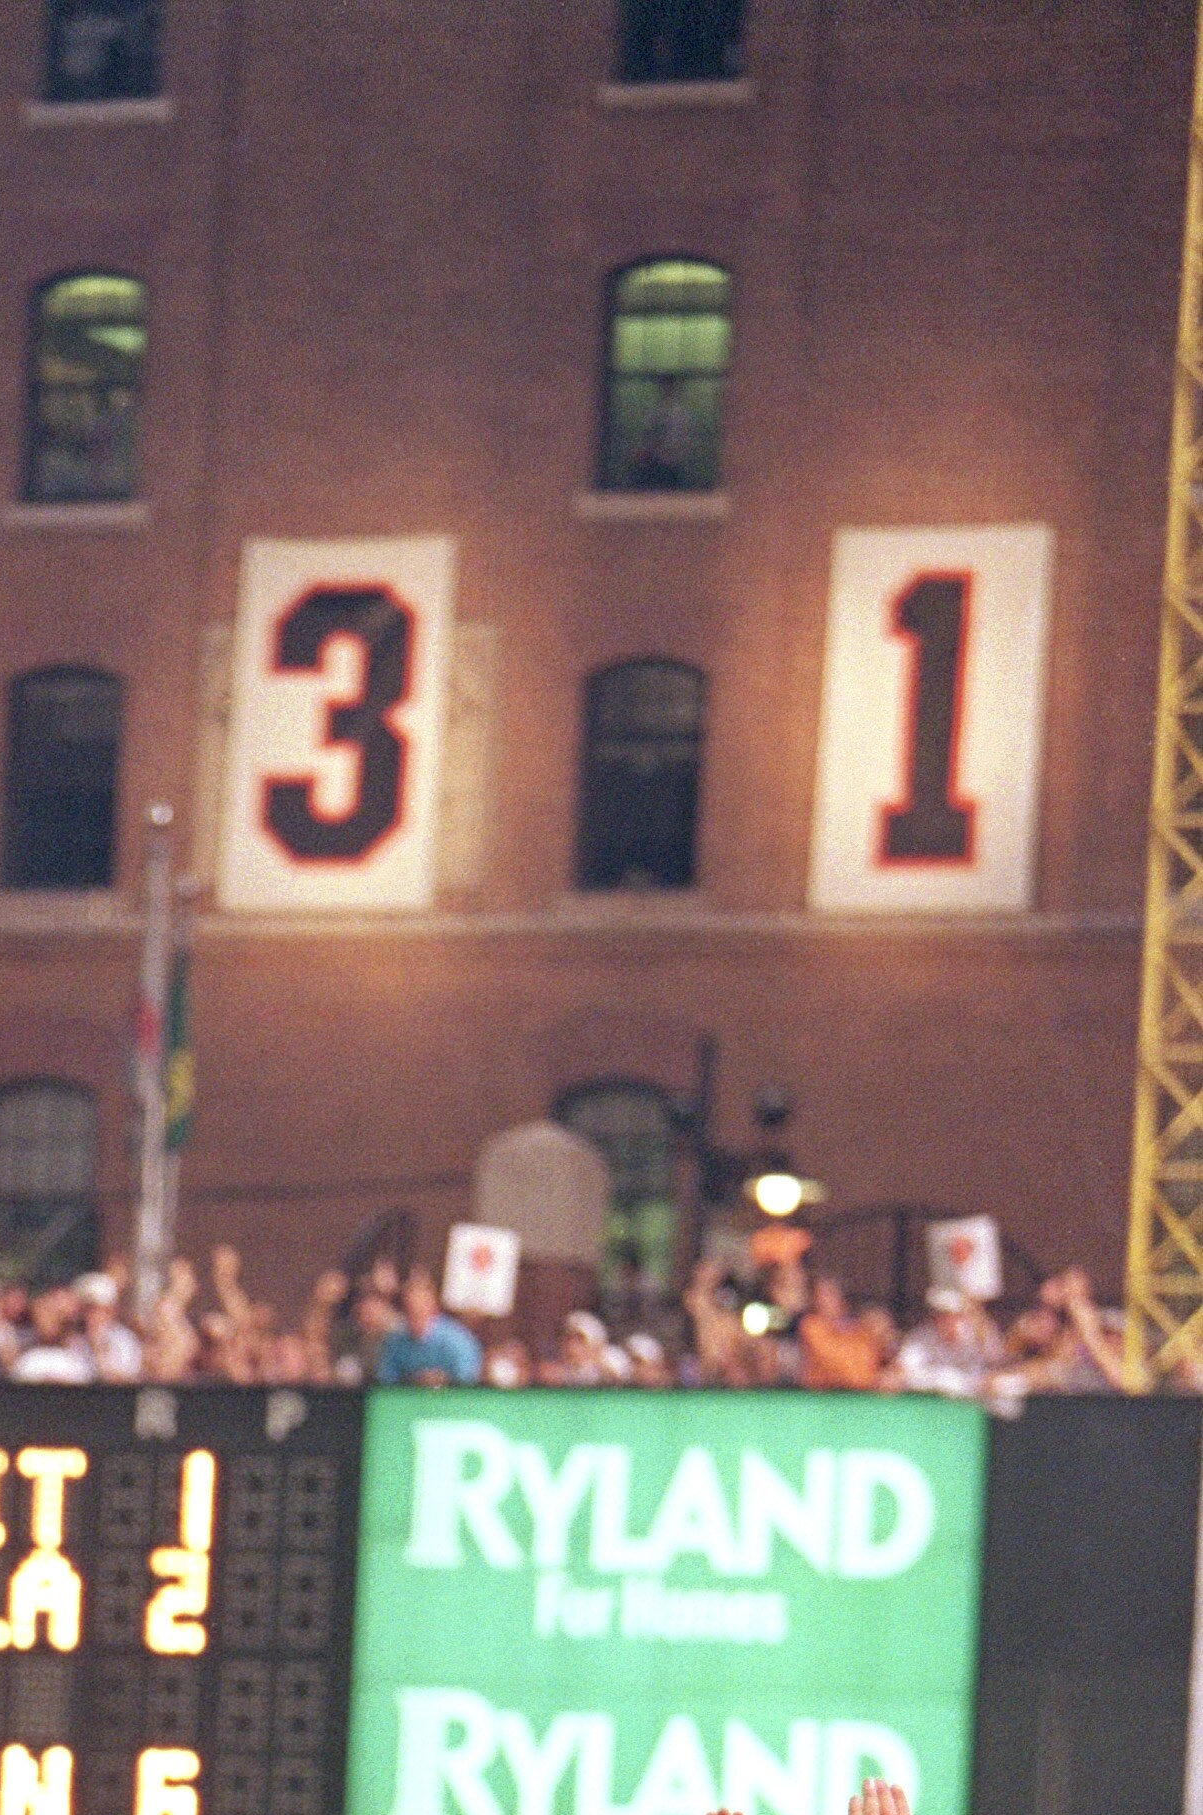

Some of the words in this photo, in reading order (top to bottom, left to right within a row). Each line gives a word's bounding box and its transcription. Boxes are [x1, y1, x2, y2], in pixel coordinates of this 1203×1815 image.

[261, 581, 416, 866] 3
[877, 571, 976, 866] 1
[180, 1449, 215, 1550] 1
[146, 1546, 210, 1654] 2
